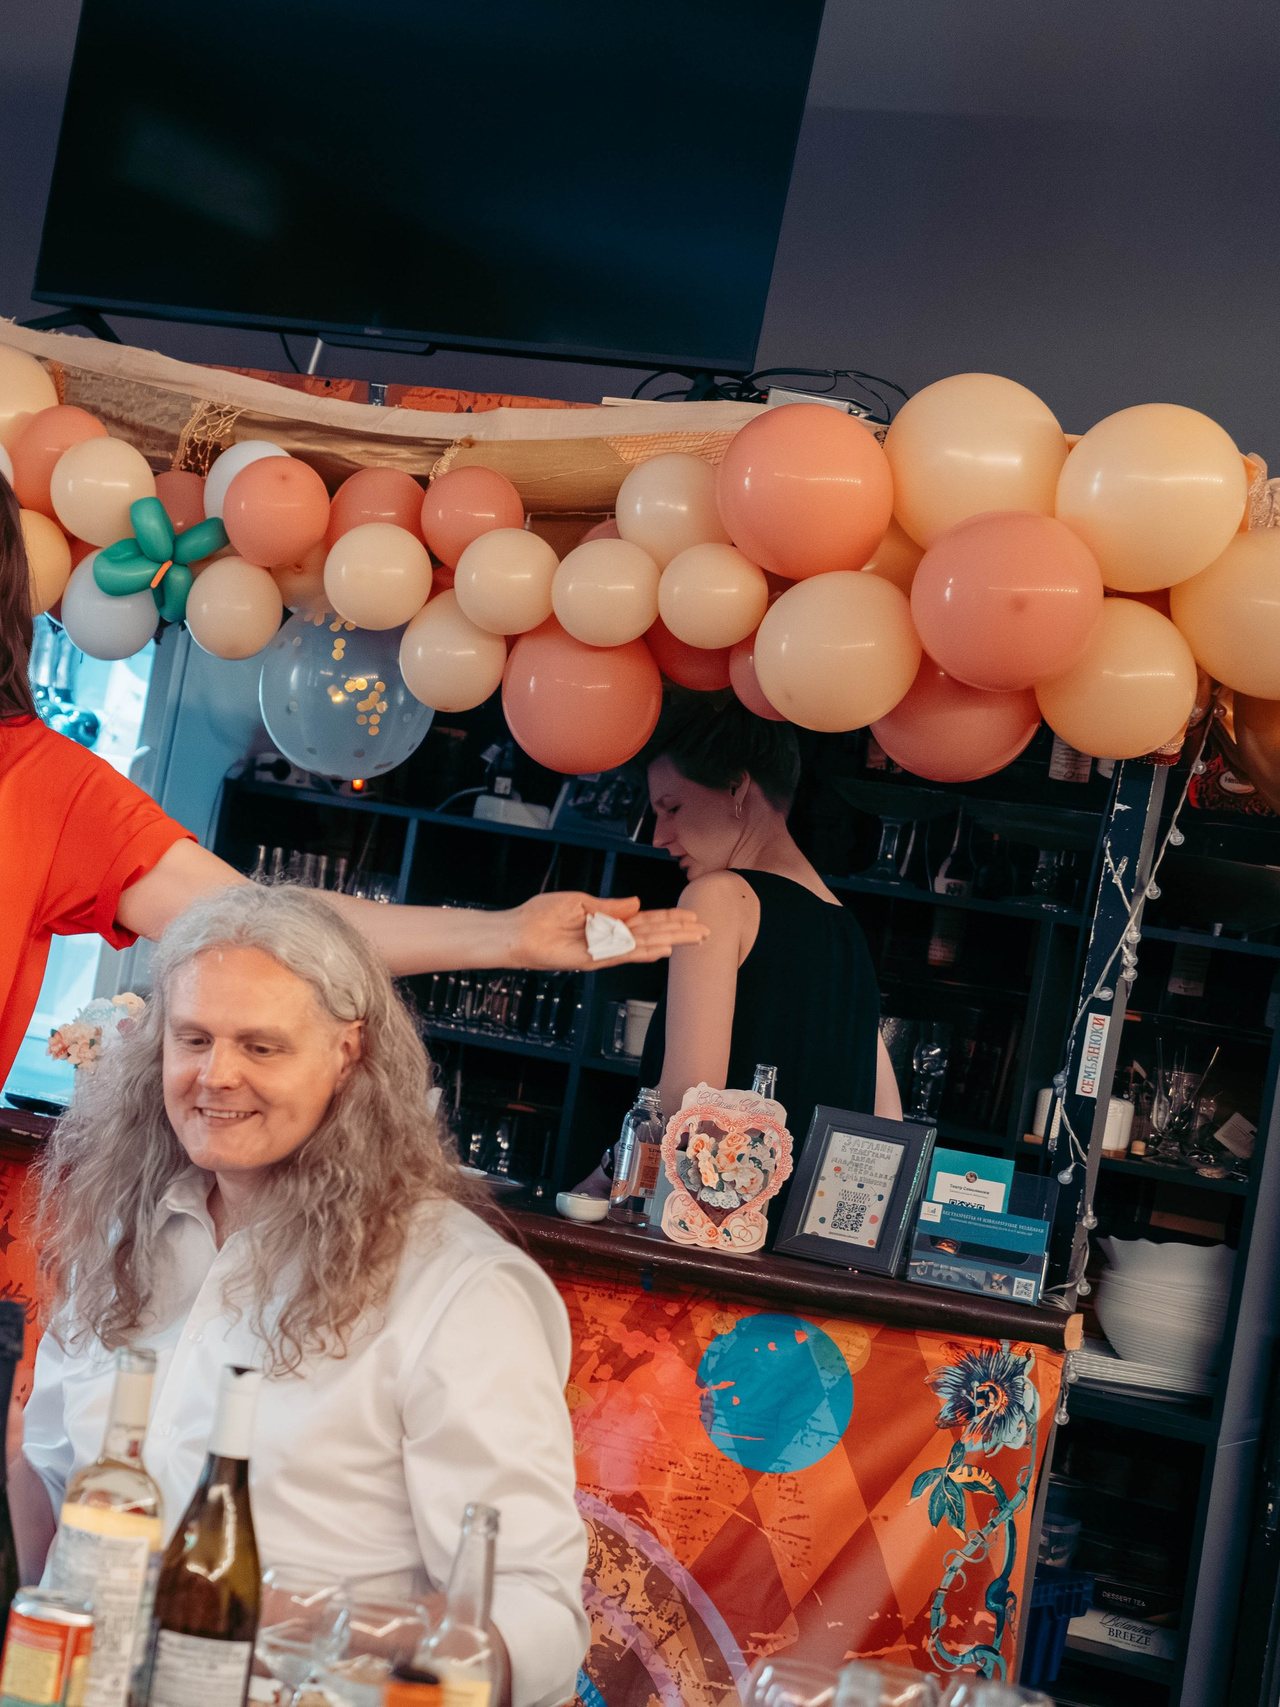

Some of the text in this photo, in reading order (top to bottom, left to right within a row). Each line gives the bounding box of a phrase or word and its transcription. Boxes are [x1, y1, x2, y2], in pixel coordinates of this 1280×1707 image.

[1081, 1016, 1106, 1095] СЕМЬЯНЮКИ
[1102, 1591, 1146, 1607] DESSERT TEA
[1107, 1627, 1151, 1646] BREEZE
